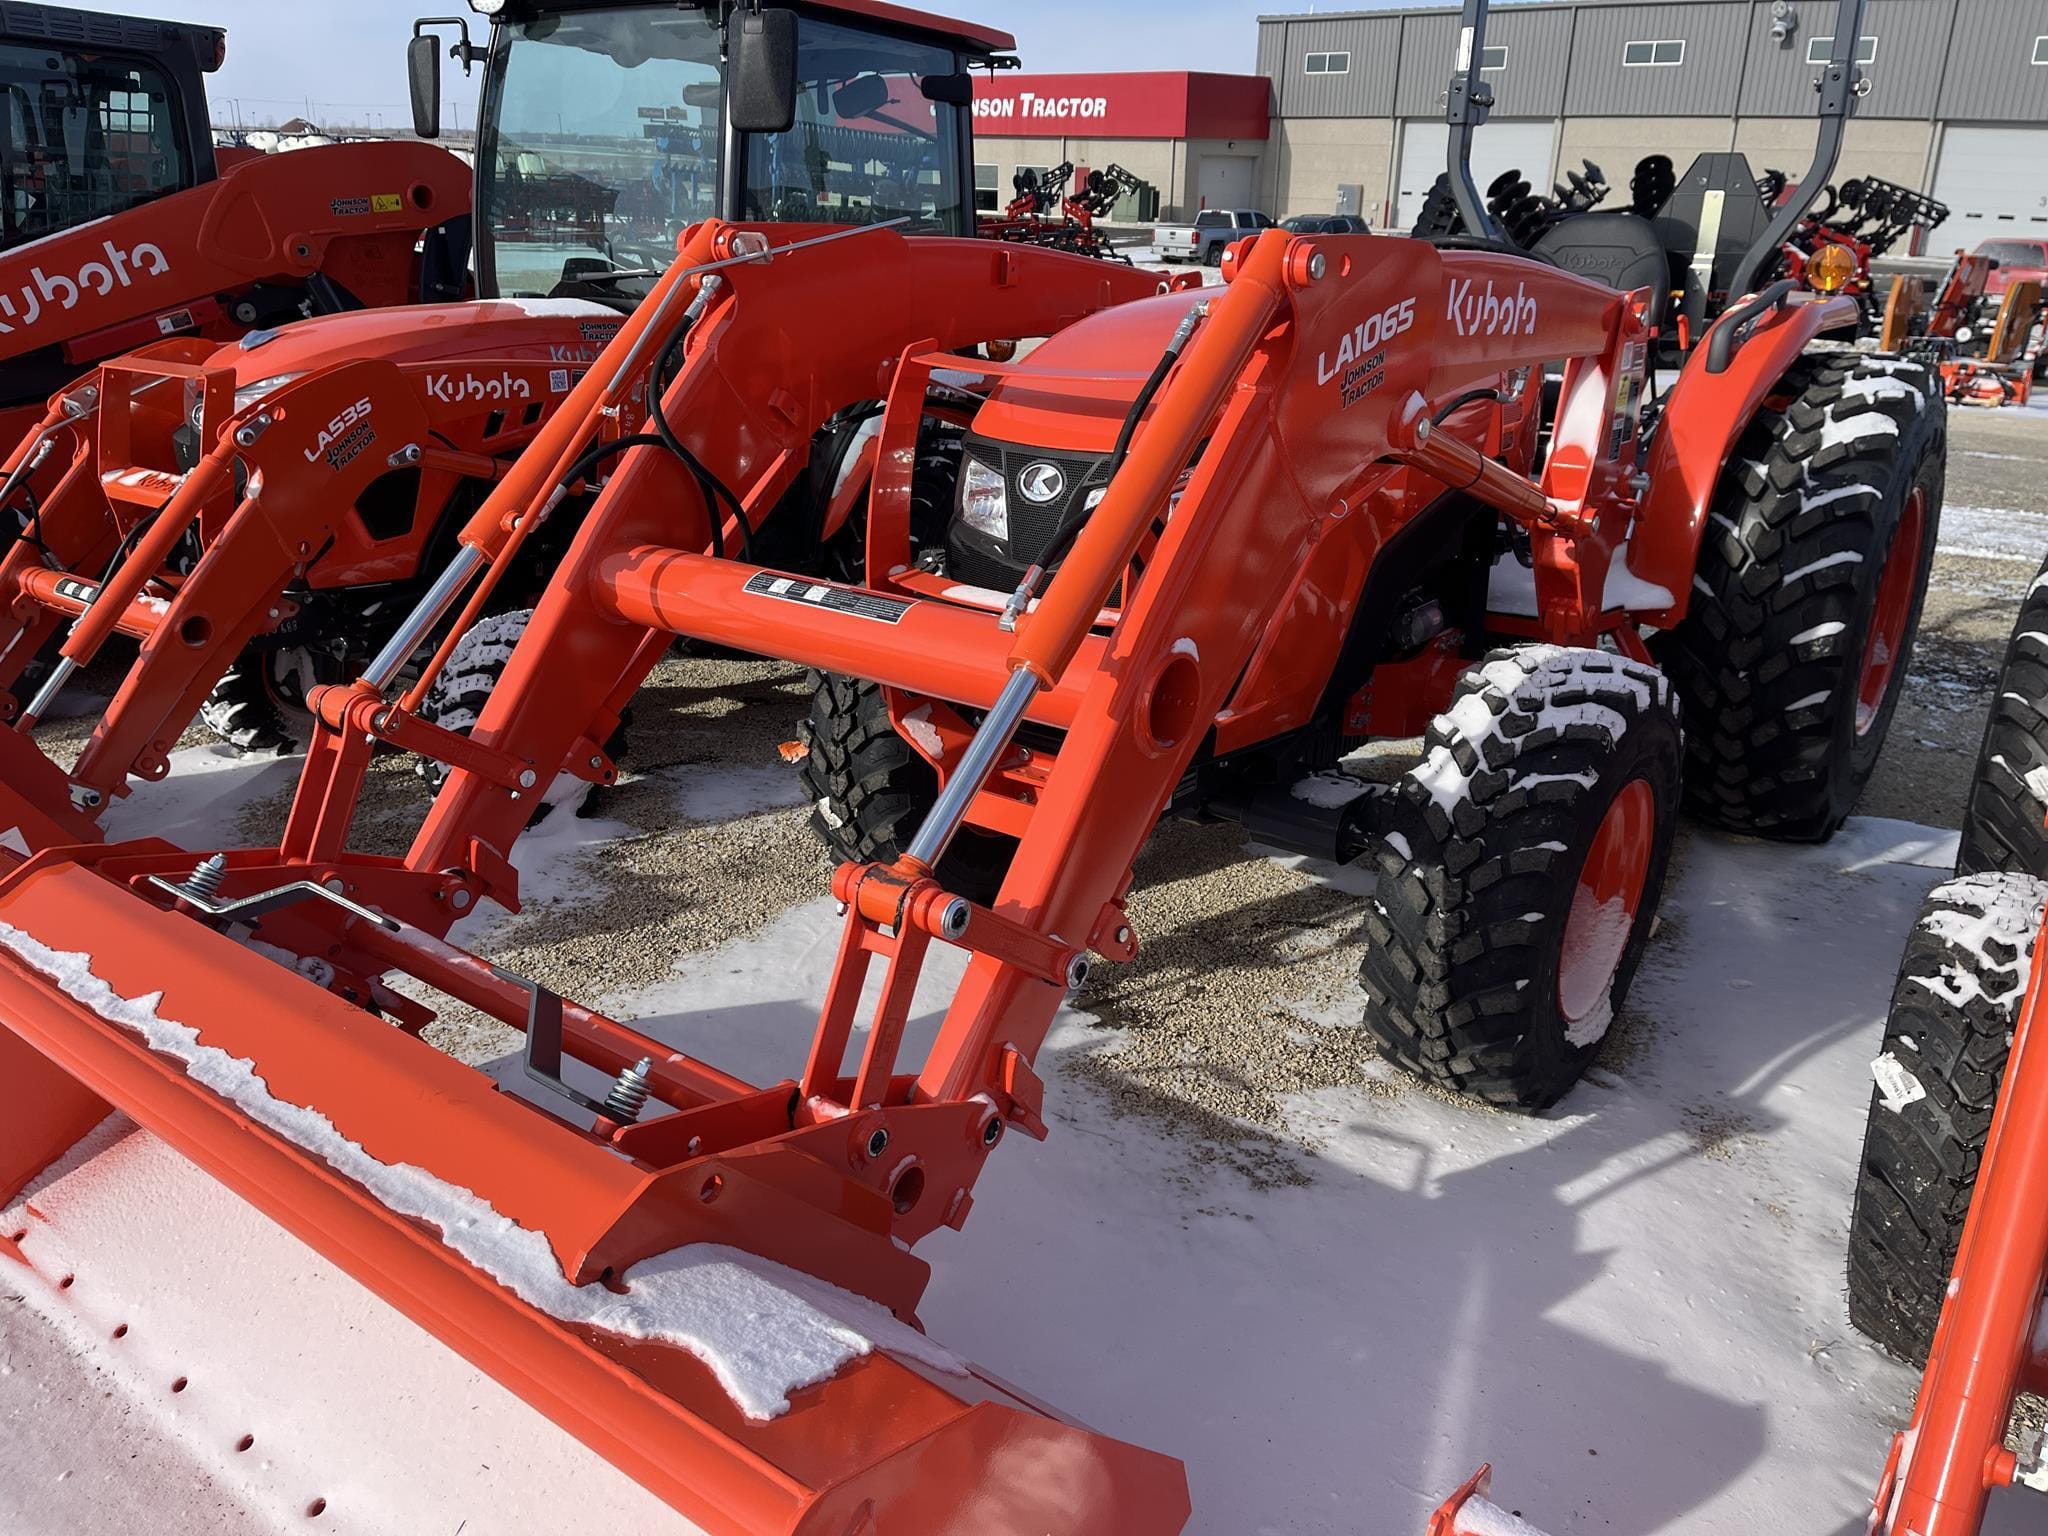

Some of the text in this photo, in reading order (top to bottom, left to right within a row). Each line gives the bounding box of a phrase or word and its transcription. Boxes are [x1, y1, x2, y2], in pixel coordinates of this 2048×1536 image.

[1020, 92, 1107, 118] TRACTOR
[330, 198, 369, 209] JOHNSON
[331, 207, 370, 216] TRACTOR
[1563, 253, 1626, 270] Kubota
[0, 240, 170, 333] ubota
[579, 321, 618, 331] JOHNSON
[1447, 278, 1537, 336] Kubota
[582, 330, 617, 341] TRACTO
[1318, 296, 1417, 386] LA1065
[426, 371, 530, 402] Kubota
[1340, 350, 1385, 390] JOHNSON
[1341, 370, 1385, 410] TRACTOR
[303, 396, 372, 462] LA535
[326, 420, 370, 464] JOHNSON
[330, 431, 377, 472] TRACTOR
